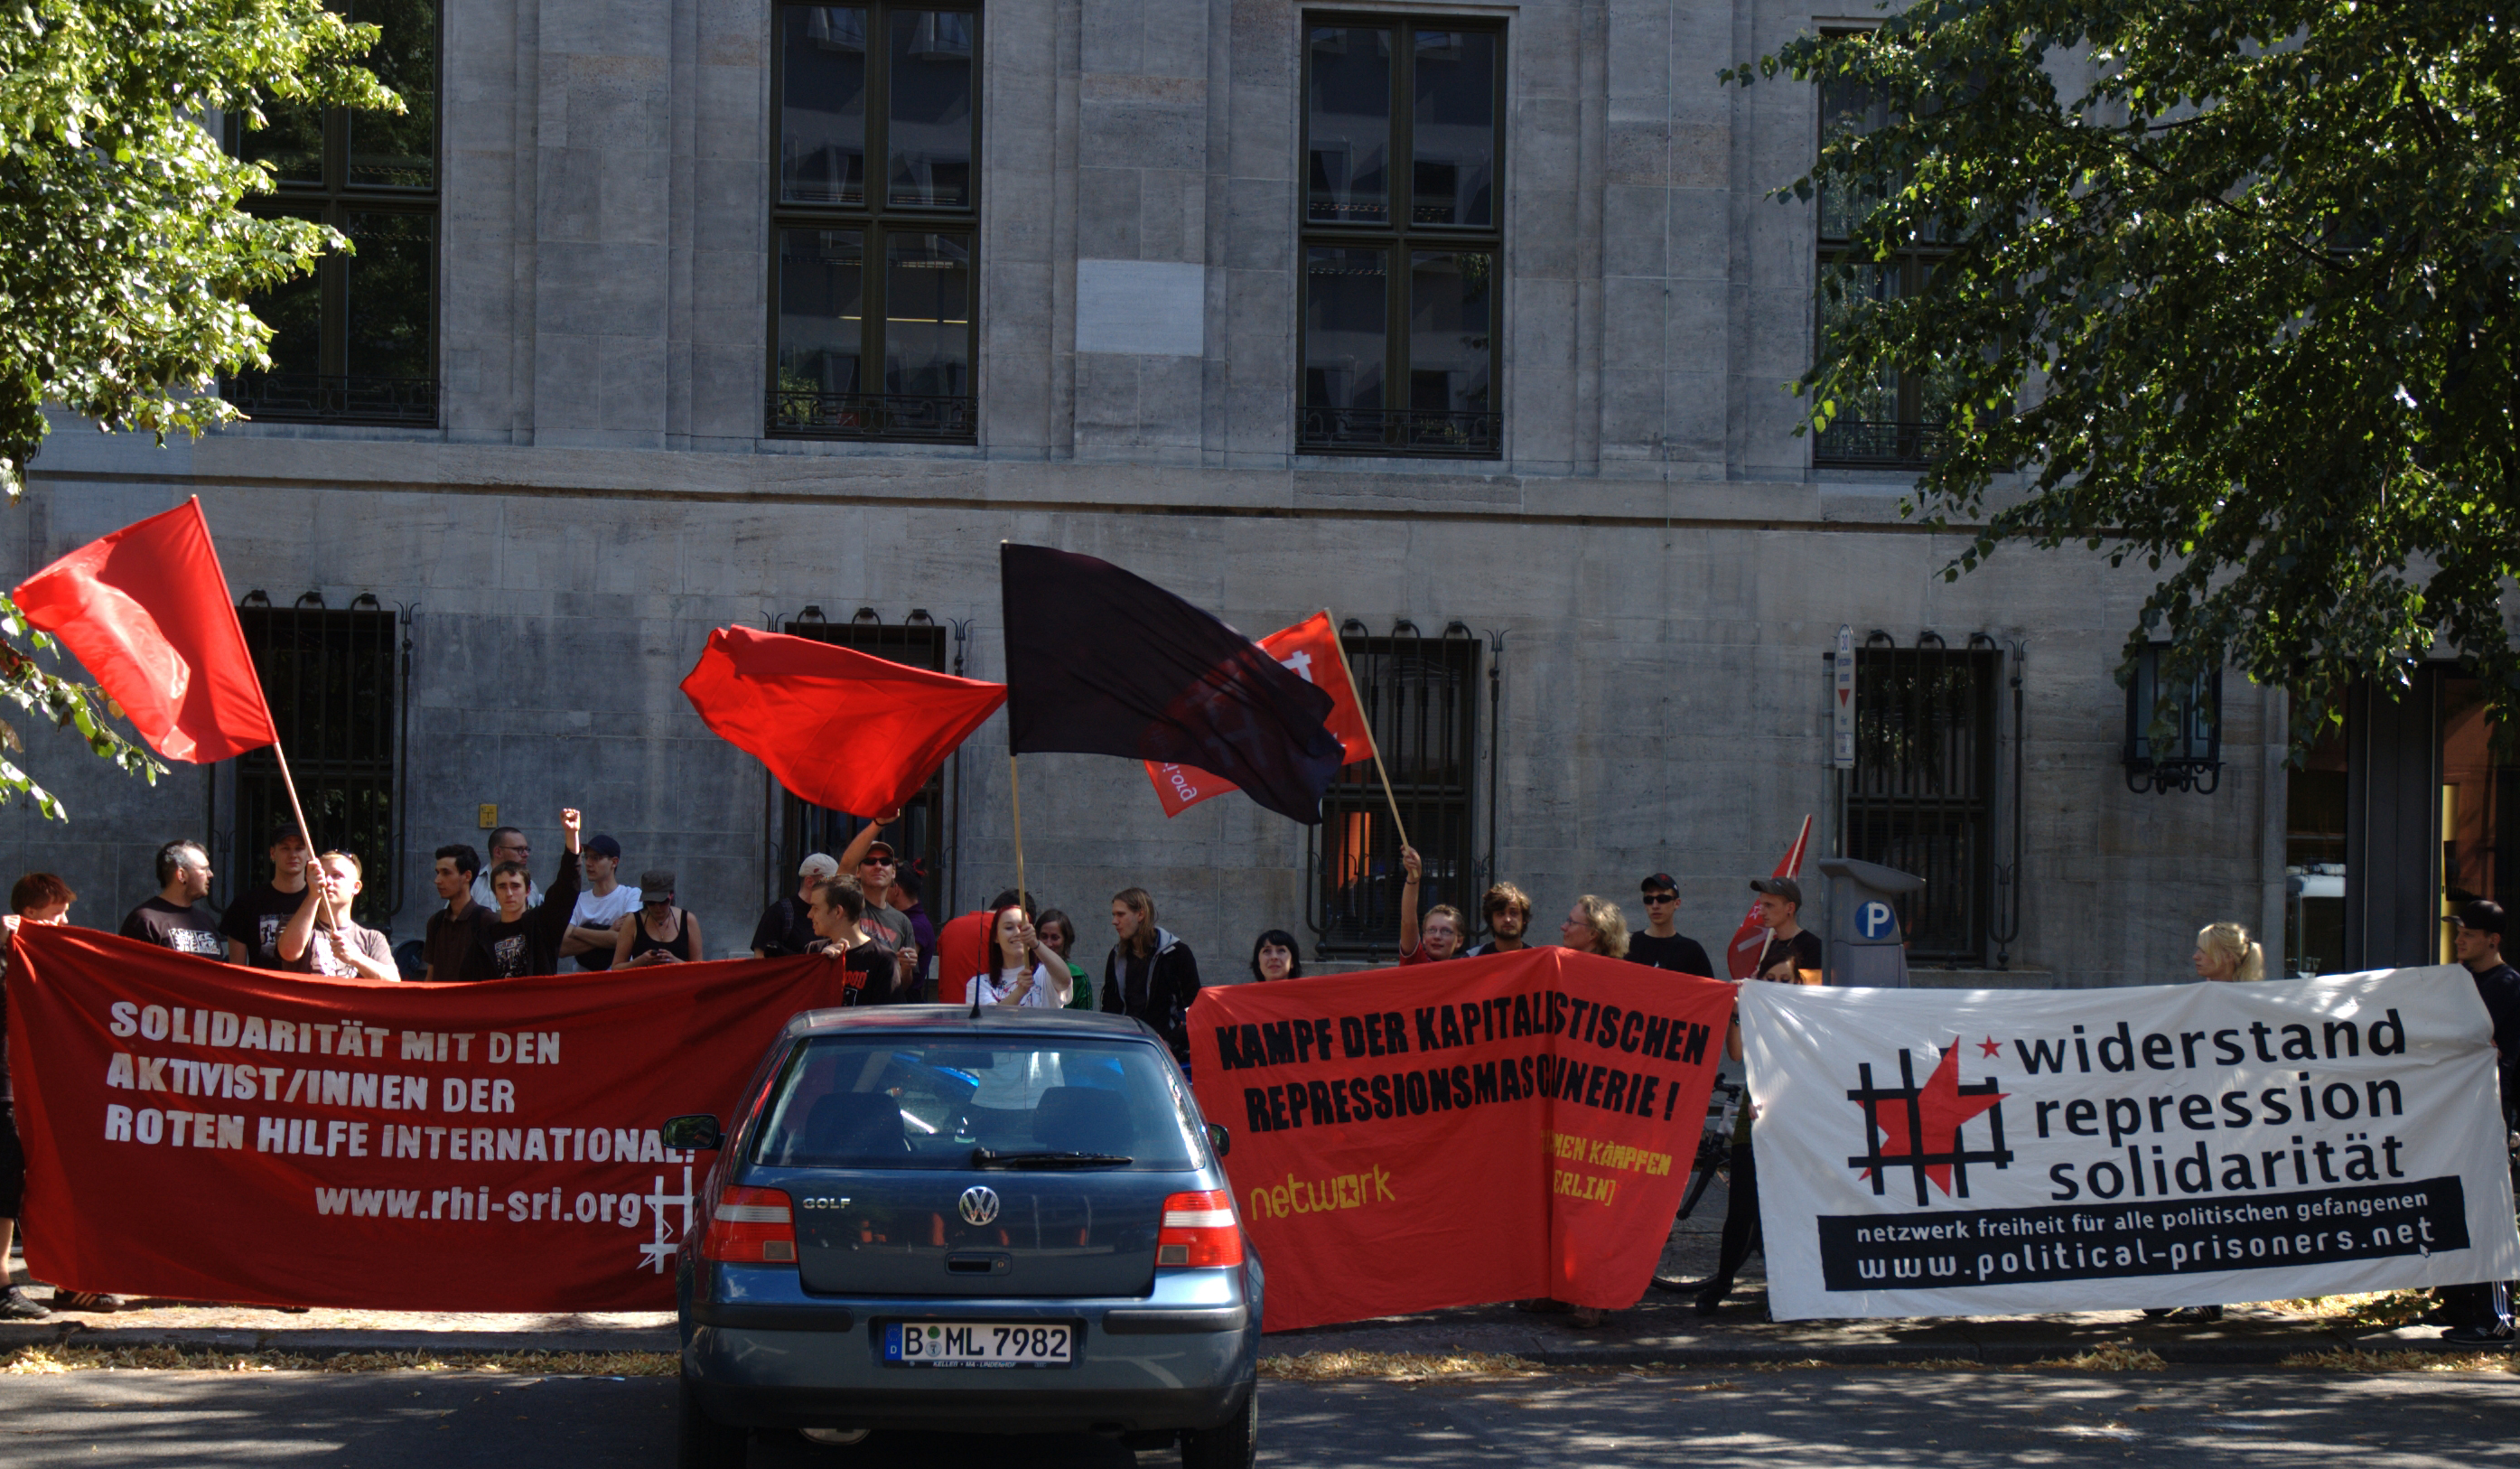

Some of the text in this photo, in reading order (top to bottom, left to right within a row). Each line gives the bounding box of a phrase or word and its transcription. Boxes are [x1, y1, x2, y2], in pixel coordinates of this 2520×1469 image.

[1867, 902, 1890, 937] P
[109, 1001, 560, 1064] SOLIDARITÄT MIT DEN
[1216, 990, 1711, 1071] KAMPF DER KAPITALISTISCHEN
[2013, 1008, 2406, 1075] widerstand
[107, 1053, 515, 1113] AKTIVIST/INNEN DER
[2035, 1071, 2403, 1147] repression
[105, 1104, 245, 1150] ROTEN
[257, 1117, 369, 1157] HILFE
[1251, 1164, 1395, 1221] network
[2049, 1133, 2404, 1201] solidarität
[315, 1186, 641, 1227] www.rhi-sri.org
[802, 1198, 851, 1209] GOLF
[1857, 1193, 2428, 1242] netzwerk freiheit für alle politischen gefangenen
[1858, 1217, 2435, 1281] www.political-prisoners.net
[890, 1345, 897, 1354] D
[905, 1327, 1067, 1357] B ML 7982
